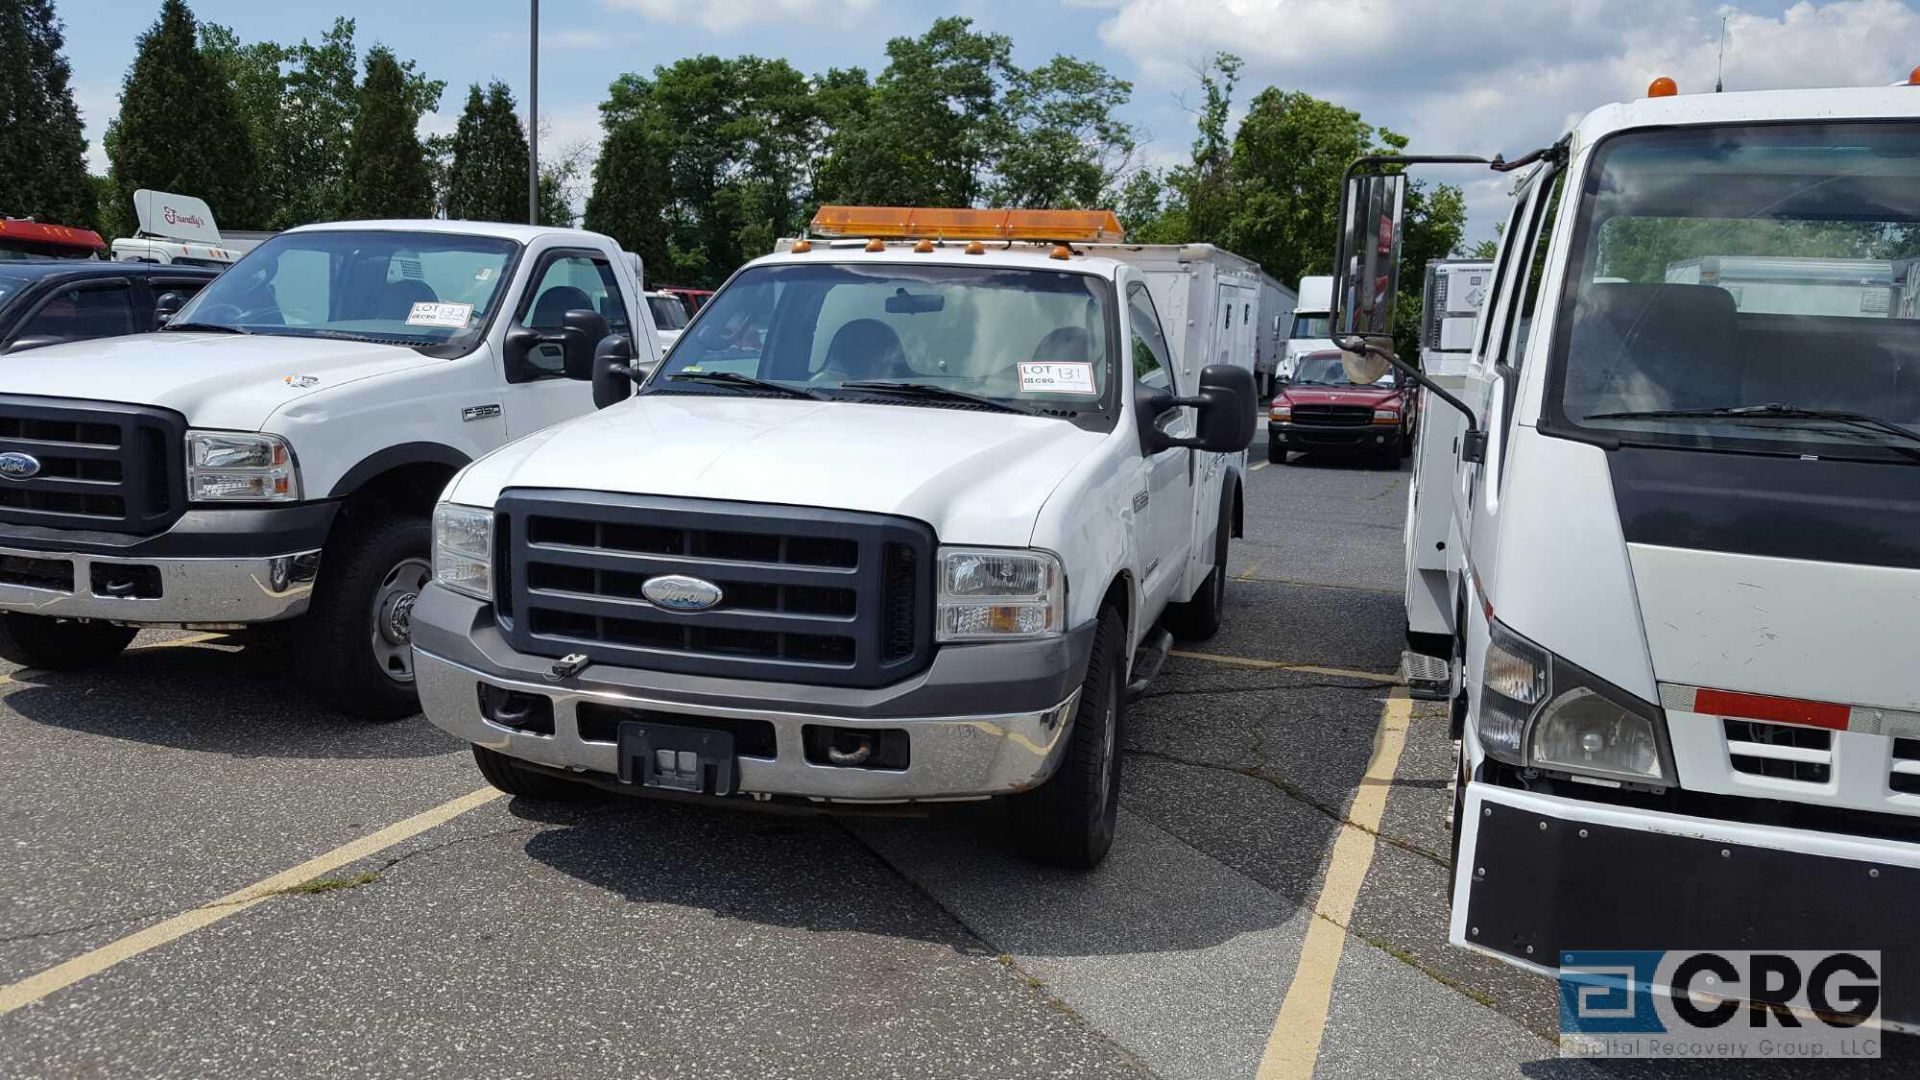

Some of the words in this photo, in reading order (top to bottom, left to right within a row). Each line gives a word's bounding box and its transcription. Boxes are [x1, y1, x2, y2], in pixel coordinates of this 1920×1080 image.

[415, 304, 438, 312] LOT
[440, 307, 465, 318] 132
[1023, 365, 1052, 374] LOT
[1058, 367, 1080, 379] 131
[662, 582, 700, 603] Ford
